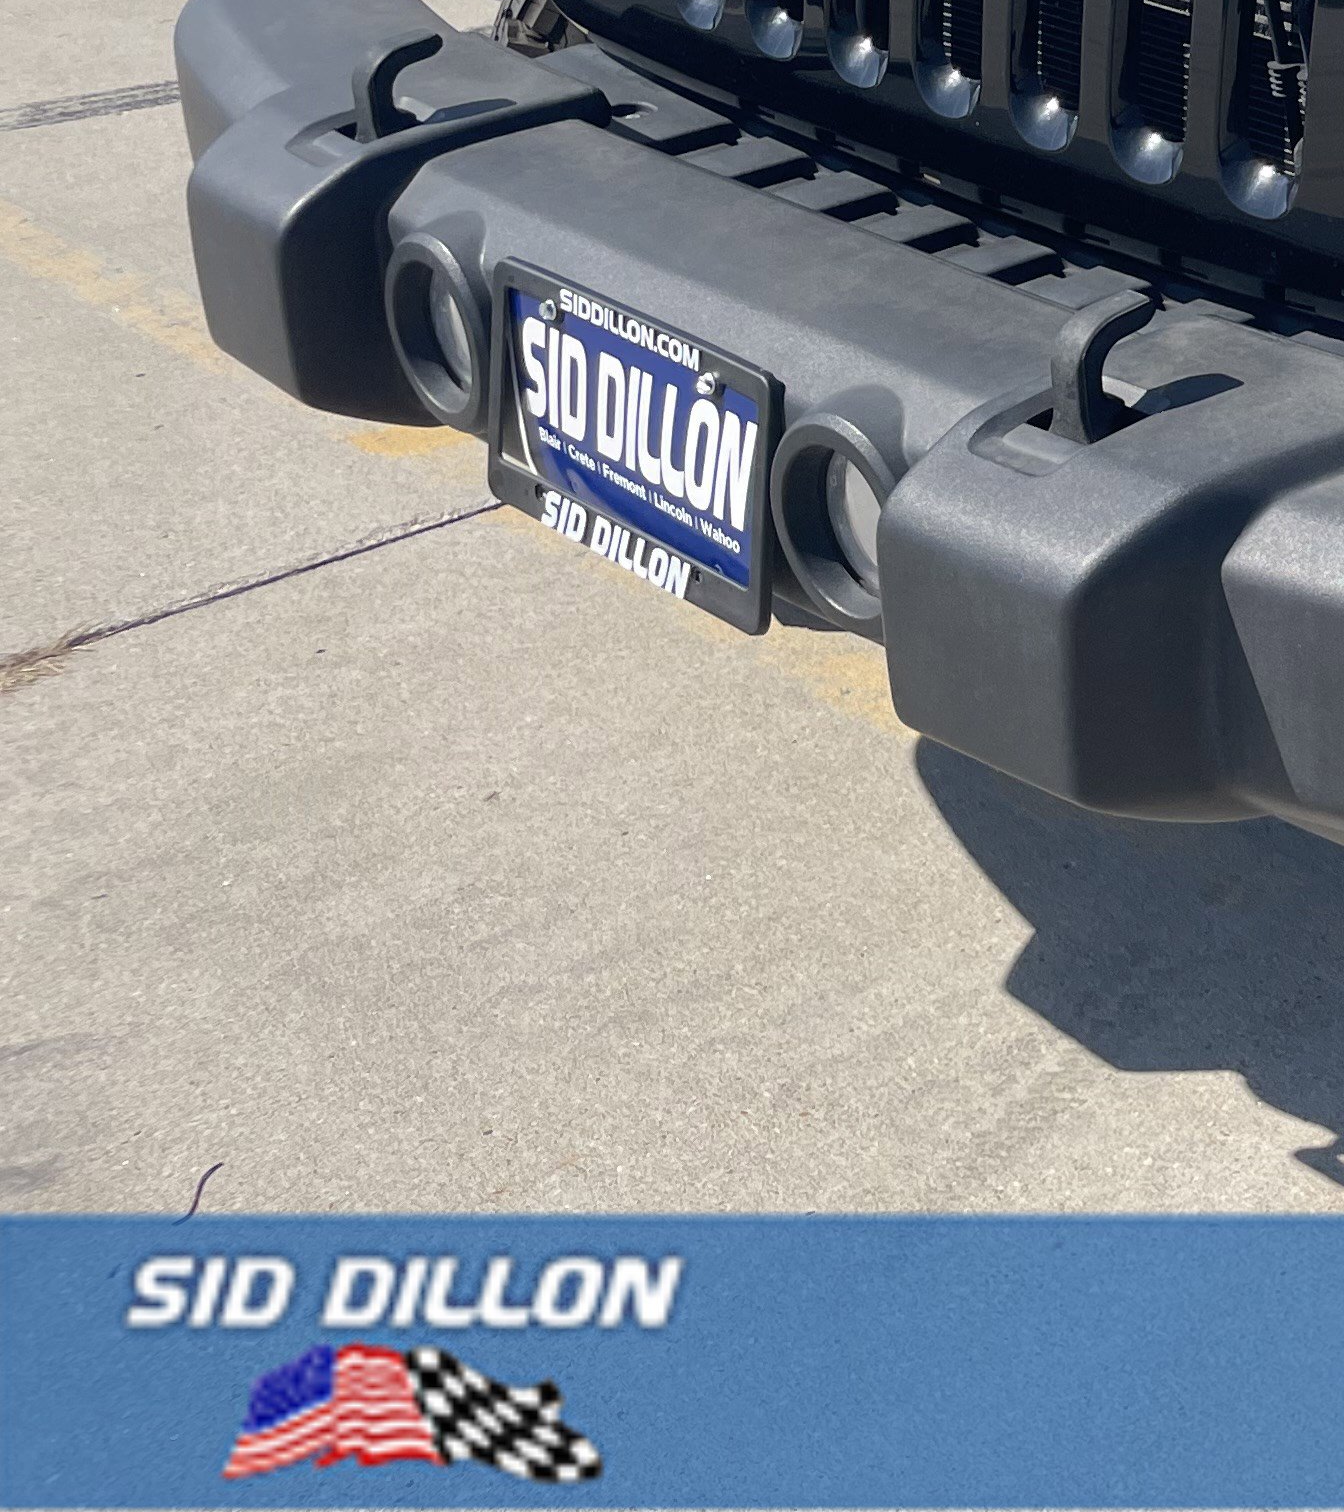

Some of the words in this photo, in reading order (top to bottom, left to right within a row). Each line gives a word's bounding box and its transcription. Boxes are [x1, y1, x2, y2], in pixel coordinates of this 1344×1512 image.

[559, 288, 701, 372] SIDDILLON.COM
[522, 316, 587, 442] SID
[597, 351, 759, 532] DILLON
[539, 426, 562, 452] Blair
[567, 442, 596, 473] Crete
[602, 462, 647, 502] Fremont
[653, 492, 693, 527] Lincoln
[700, 518, 741, 554] Wahoo
[541, 489, 587, 544] SID
[590, 515, 692, 599] DILLON
